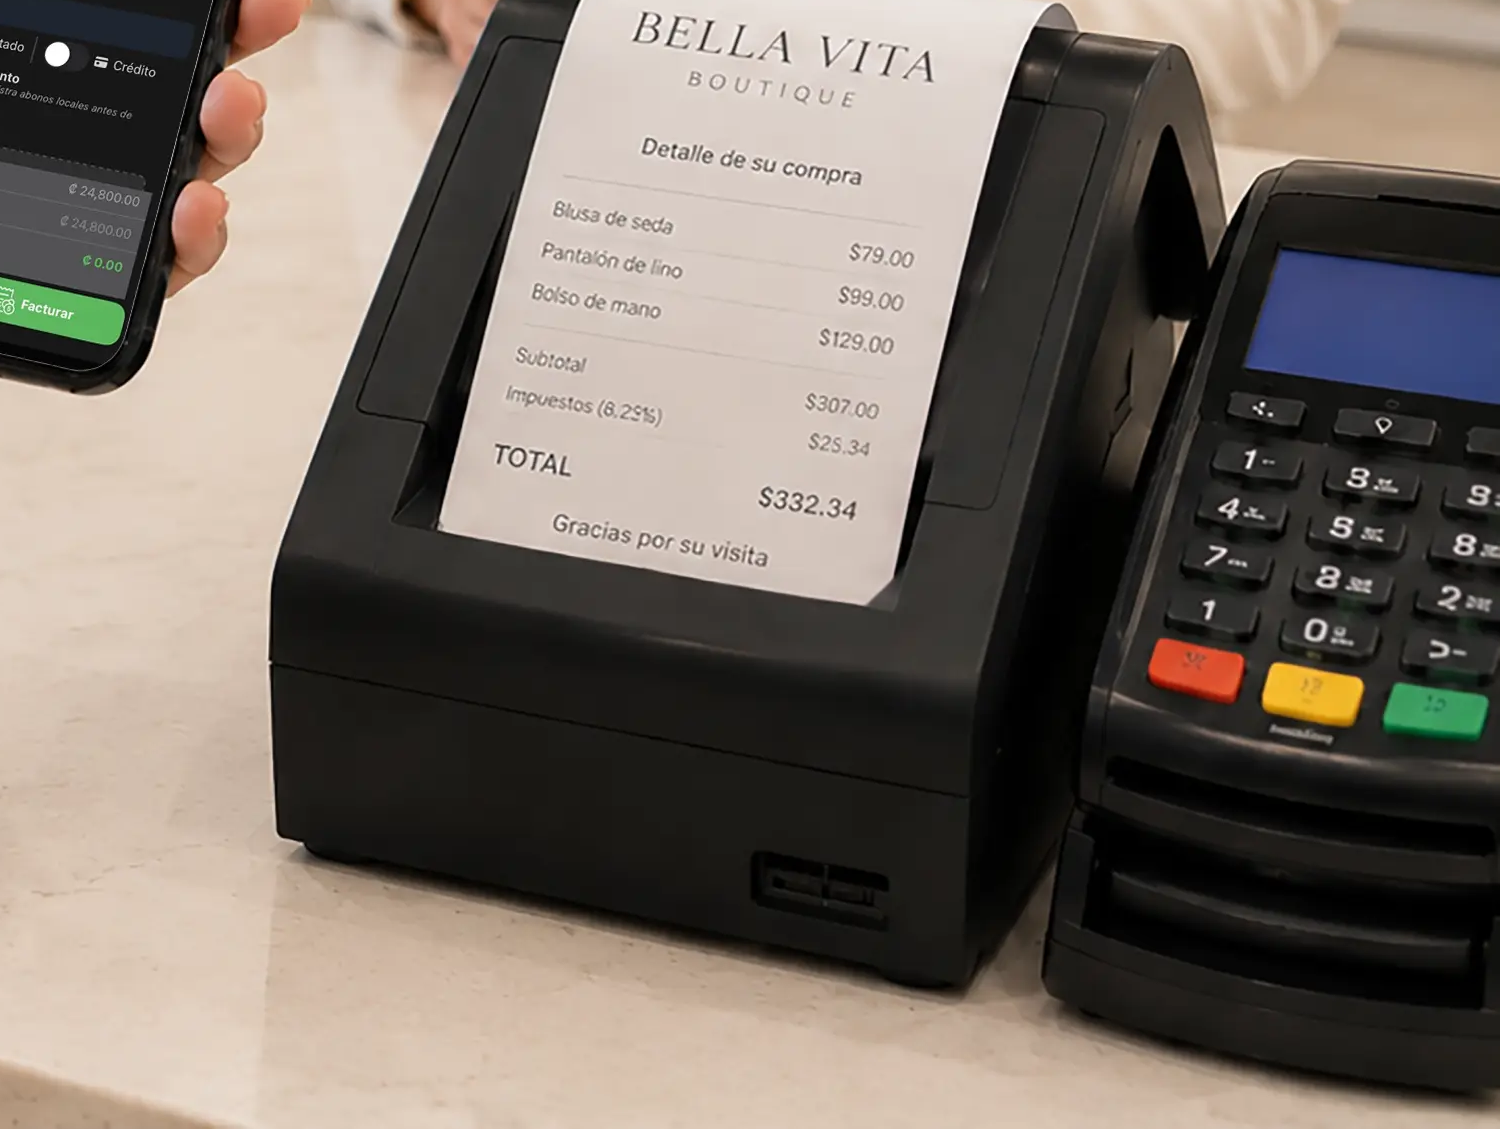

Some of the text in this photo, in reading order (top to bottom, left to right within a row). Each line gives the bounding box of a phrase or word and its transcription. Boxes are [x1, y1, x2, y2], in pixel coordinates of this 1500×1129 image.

[631, 11, 935, 83] BELLA VITA
[113, 60, 156, 78] Crédito
[688, 71, 856, 109] BOUTIQUE
[20, 91, 54, 104] abonos
[56, 97, 89, 111] locales
[91, 105, 117, 117] antes
[120, 109, 133, 120] de
[641, 137, 863, 186] Detalle de su compra
[79, 184, 140, 207] 24,800.00
[71, 217, 132, 240] 24,800.00
[552, 202, 673, 236] Blusa de seda
[94, 257, 123, 272] 0.00
[541, 242, 683, 281] Pantalón de lino
[848, 243, 914, 269] $79.00
[21, 299, 74, 320] Facturar
[531, 284, 661, 321] Bolso de mano
[838, 285, 904, 312] $99.00
[818, 328, 894, 355] $129.00
[516, 348, 587, 373] Subtotal
[506, 386, 592, 414] Impuestos
[805, 393, 879, 420] $307.00
[808, 434, 870, 458] $25.34
[494, 444, 572, 477] TOTAL
[758, 485, 857, 520] $332.34
[1218, 498, 1239, 520] 4
[553, 513, 769, 569] Gracias por su visita
[1204, 546, 1227, 567] 7
[1437, 586, 1462, 610] 2
[1304, 618, 1328, 643] 0
